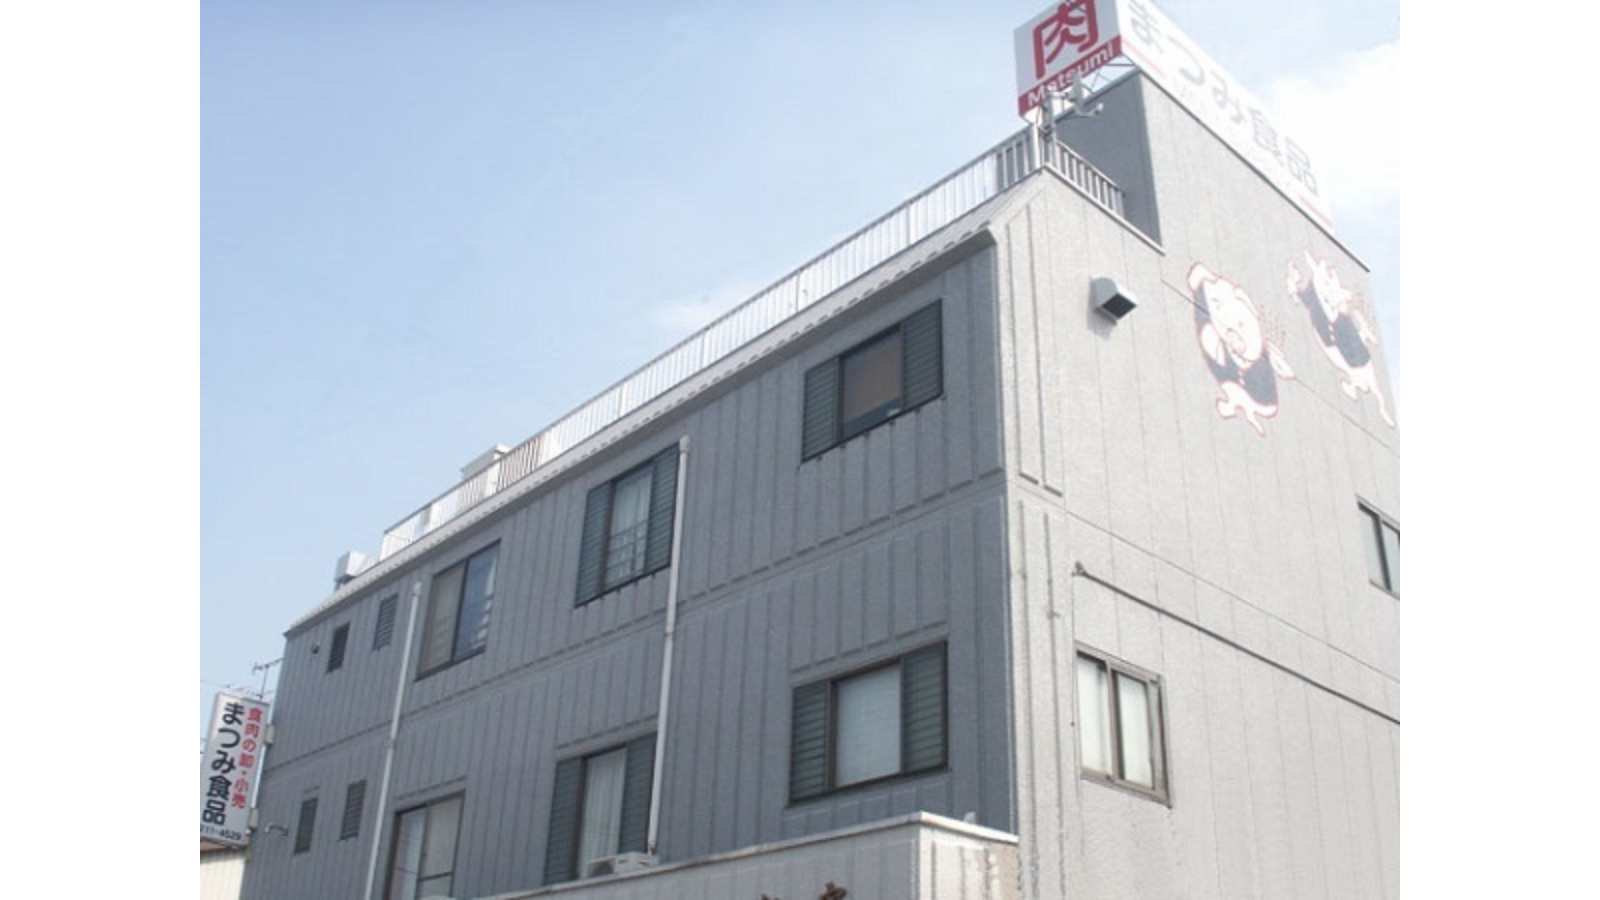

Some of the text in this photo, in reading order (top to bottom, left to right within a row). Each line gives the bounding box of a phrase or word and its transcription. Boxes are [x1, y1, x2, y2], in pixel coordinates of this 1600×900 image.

[1032, 0, 1100, 80] 肉
[1127, 0, 1319, 198] まつみ食品
[202, 702, 245, 826] まつみ食品
